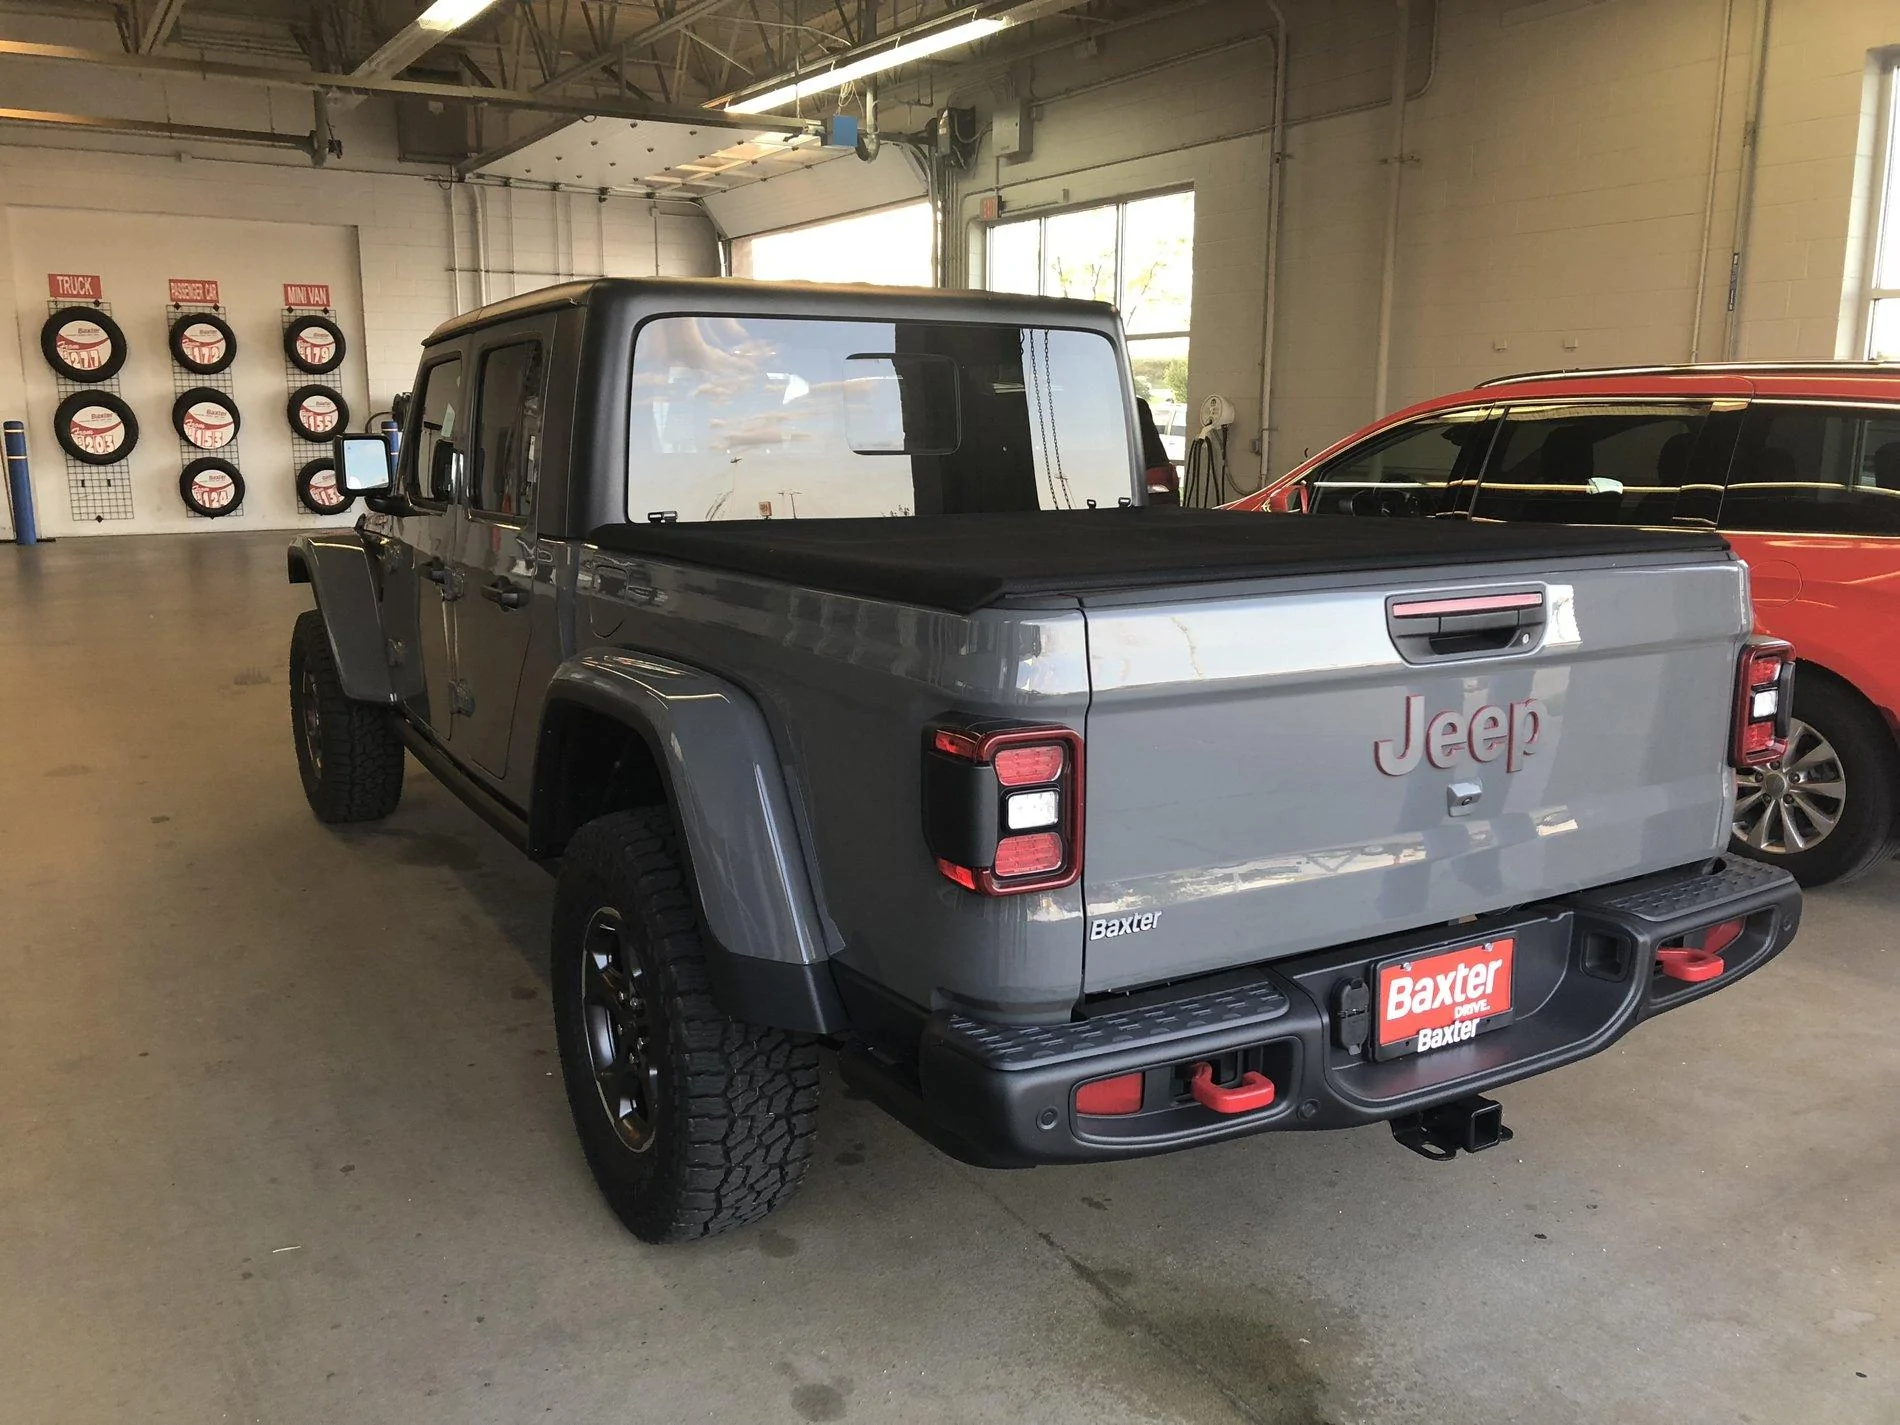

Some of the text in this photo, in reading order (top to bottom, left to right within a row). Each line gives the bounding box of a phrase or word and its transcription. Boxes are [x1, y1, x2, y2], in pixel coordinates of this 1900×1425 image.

[57, 276, 93, 295] TRUCK
[205, 283, 219, 301] CAR
[287, 286, 327, 305] MINI VAN
[206, 409, 227, 417] Baxter
[208, 474, 227, 482] Baxter
[1374, 695, 1549, 776] Jeep
[1089, 911, 1163, 940] Baxter
[1386, 959, 1503, 1021] Baxter
[1454, 999, 1491, 1019] DRIVE.
[1417, 1018, 1481, 1053] Baxter
